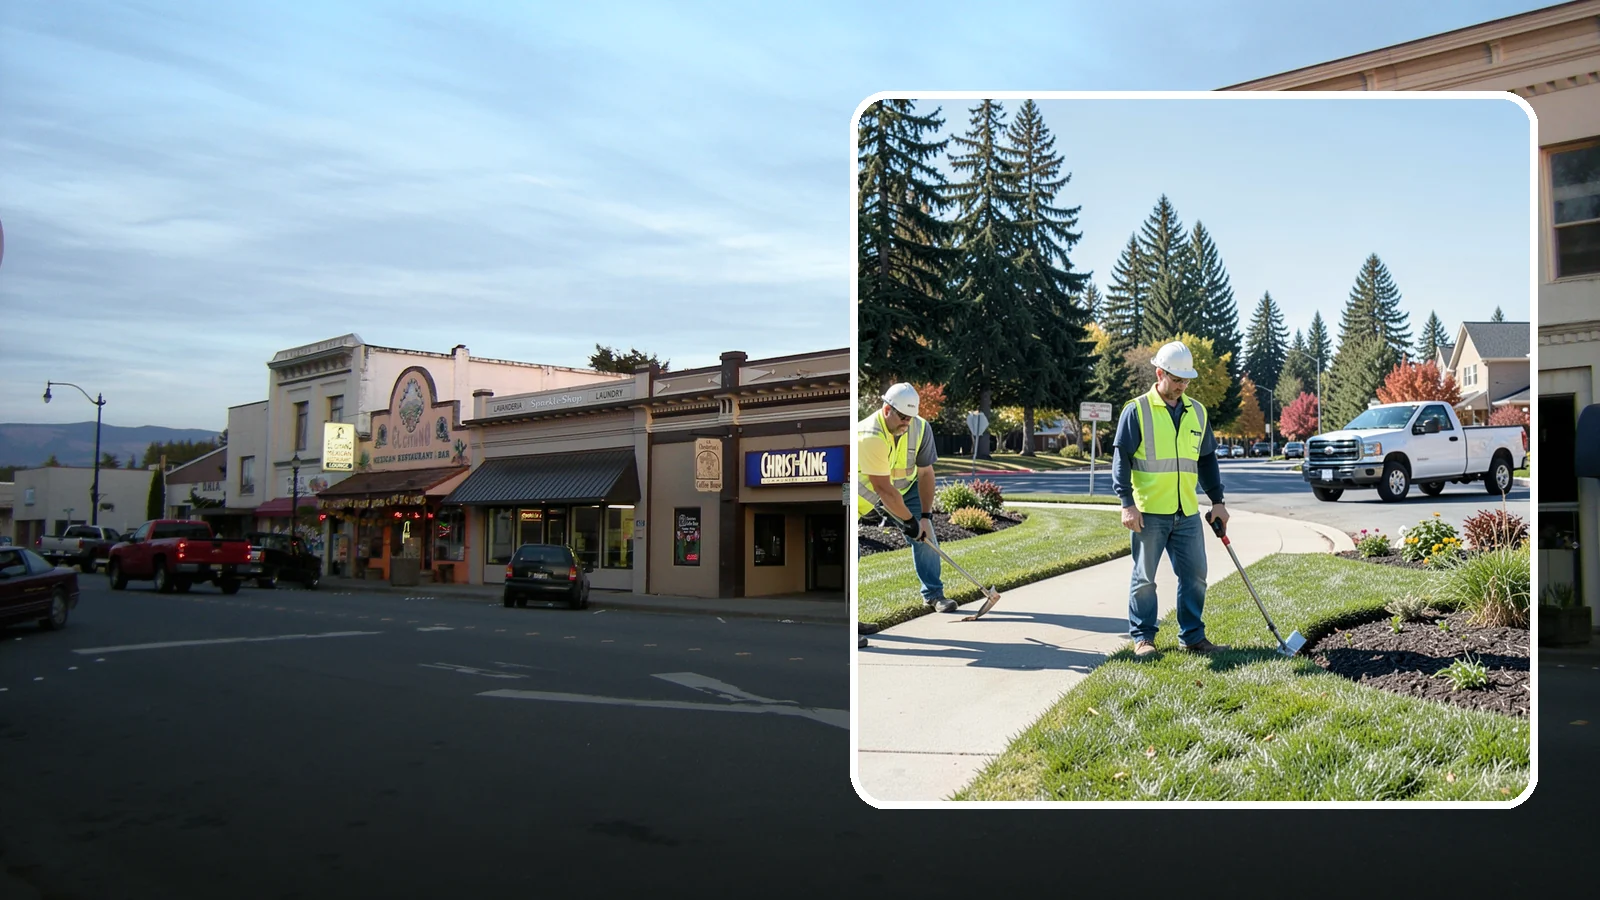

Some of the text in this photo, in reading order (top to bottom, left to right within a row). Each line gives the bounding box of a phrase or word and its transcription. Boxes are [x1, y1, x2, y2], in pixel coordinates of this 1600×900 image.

[562, 395, 582, 405] Shop
[595, 388, 624, 400] LAUNDRY
[493, 401, 522, 413] LAVANDERIA
[373, 450, 450, 464] MEXICAN RESTAURANT BAR
